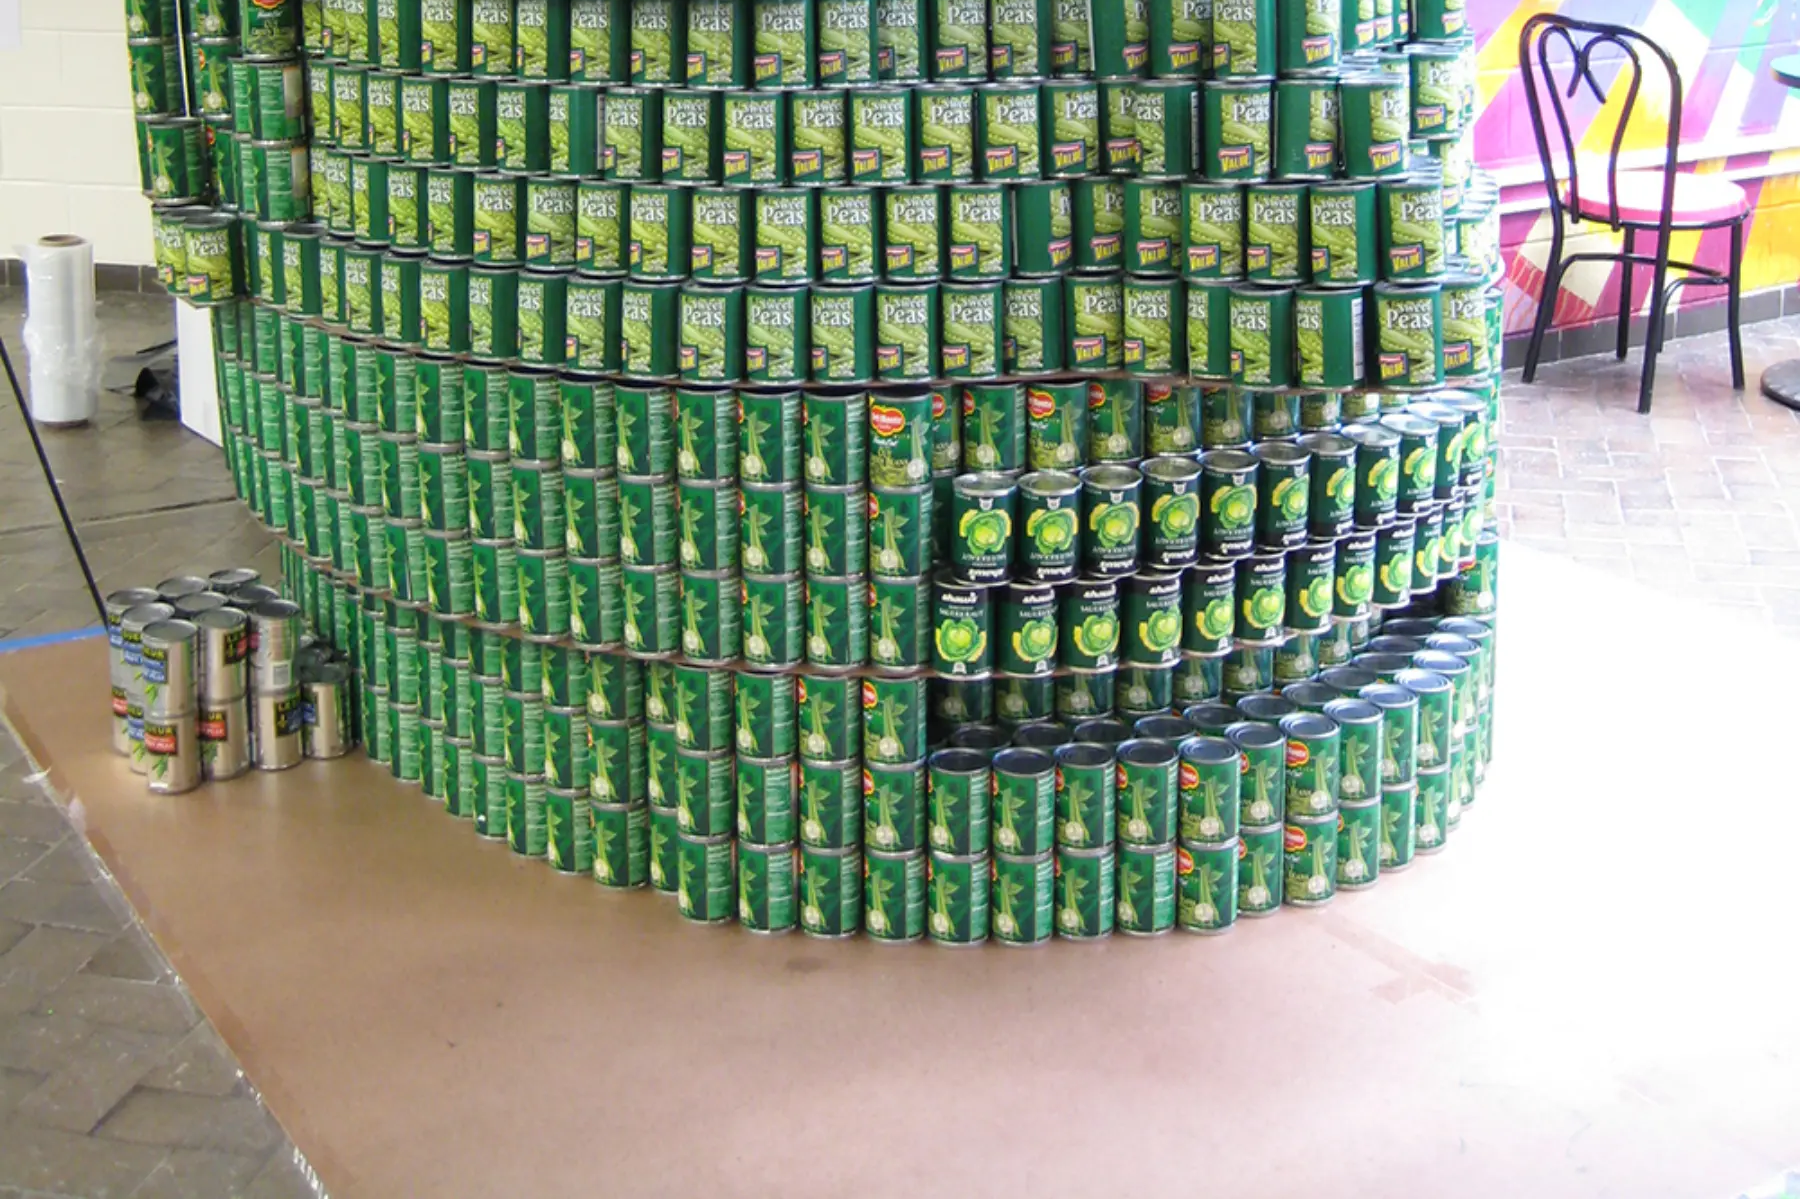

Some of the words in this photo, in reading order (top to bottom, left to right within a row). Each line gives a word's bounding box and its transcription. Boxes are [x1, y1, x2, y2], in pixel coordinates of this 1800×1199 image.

[761, 12, 804, 32] Peas
[827, 10, 868, 30] Peas
[878, 8, 917, 27] Peas
[949, 5, 986, 25] Peas
[995, 4, 1037, 24] Peas
[1215, 3, 1253, 21] Peas
[690, 13, 730, 32] Peas
[667, 107, 706, 127] Peas
[732, 109, 775, 129] Peas
[802, 108, 843, 128] Peas
[861, 108, 904, 128] Peas
[931, 106, 971, 125] Peas
[997, 104, 1036, 124] Peas
[1233, 102, 1269, 123] Peas
[533, 195, 574, 214] Peas
[697, 204, 736, 224] Peas
[894, 204, 935, 224] Peas
[959, 204, 1000, 224] Peas
[1200, 202, 1241, 223] Peas
[1254, 203, 1295, 224] Peas
[1401, 202, 1441, 222] Peas
[763, 204, 804, 226] Peas
[828, 205, 869, 225] Peas
[1313, 207, 1353, 226] Peas
[190, 234, 227, 255] Peas
[684, 306, 722, 326] Peas
[751, 306, 791, 326] Peas
[813, 307, 851, 326] Peas
[885, 304, 926, 324] Peas
[950, 303, 992, 324] Peas
[1128, 296, 1167, 318] Peas
[1231, 310, 1266, 331] Peas
[1387, 308, 1433, 330] Peas
